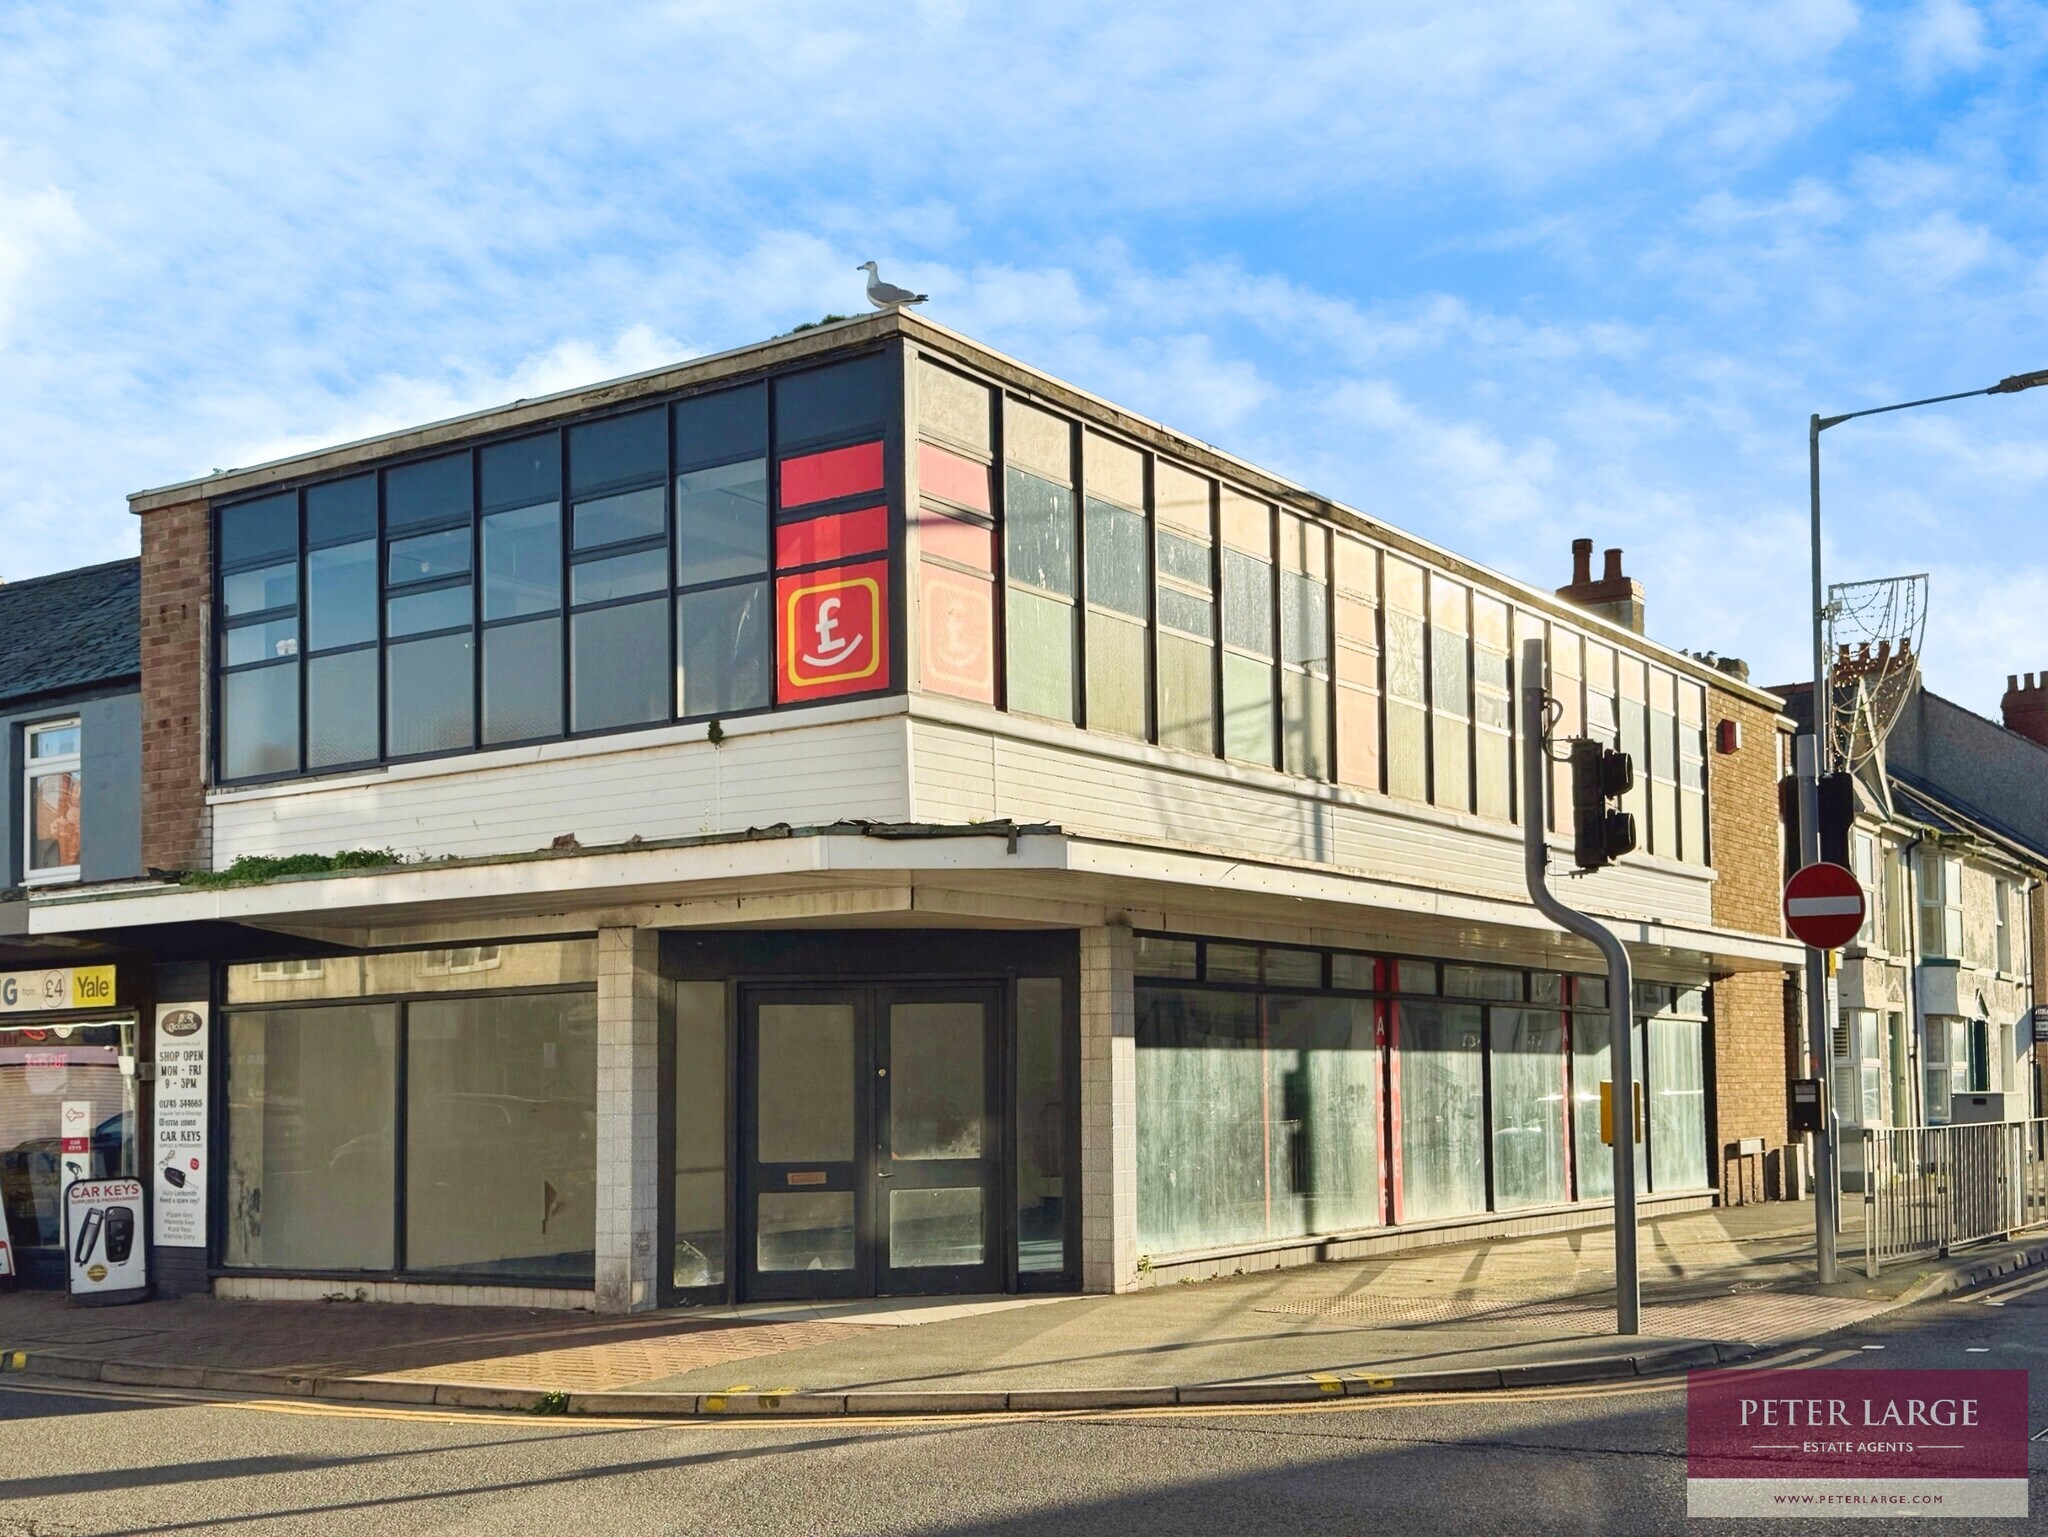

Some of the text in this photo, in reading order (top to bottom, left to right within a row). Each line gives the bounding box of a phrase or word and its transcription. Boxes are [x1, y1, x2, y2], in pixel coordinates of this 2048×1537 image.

[45, 978, 64, 998] £4
[77, 975, 110, 998] Yale
[159, 1050, 204, 1062] SHOP OPEN
[161, 1065, 178, 1076] MON
[188, 1064, 201, 1076] FRI
[165, 1078, 170, 1089] 9
[160, 1131, 201, 1142] CAR KEYS
[71, 1183, 139, 1199] CAR KEYS
